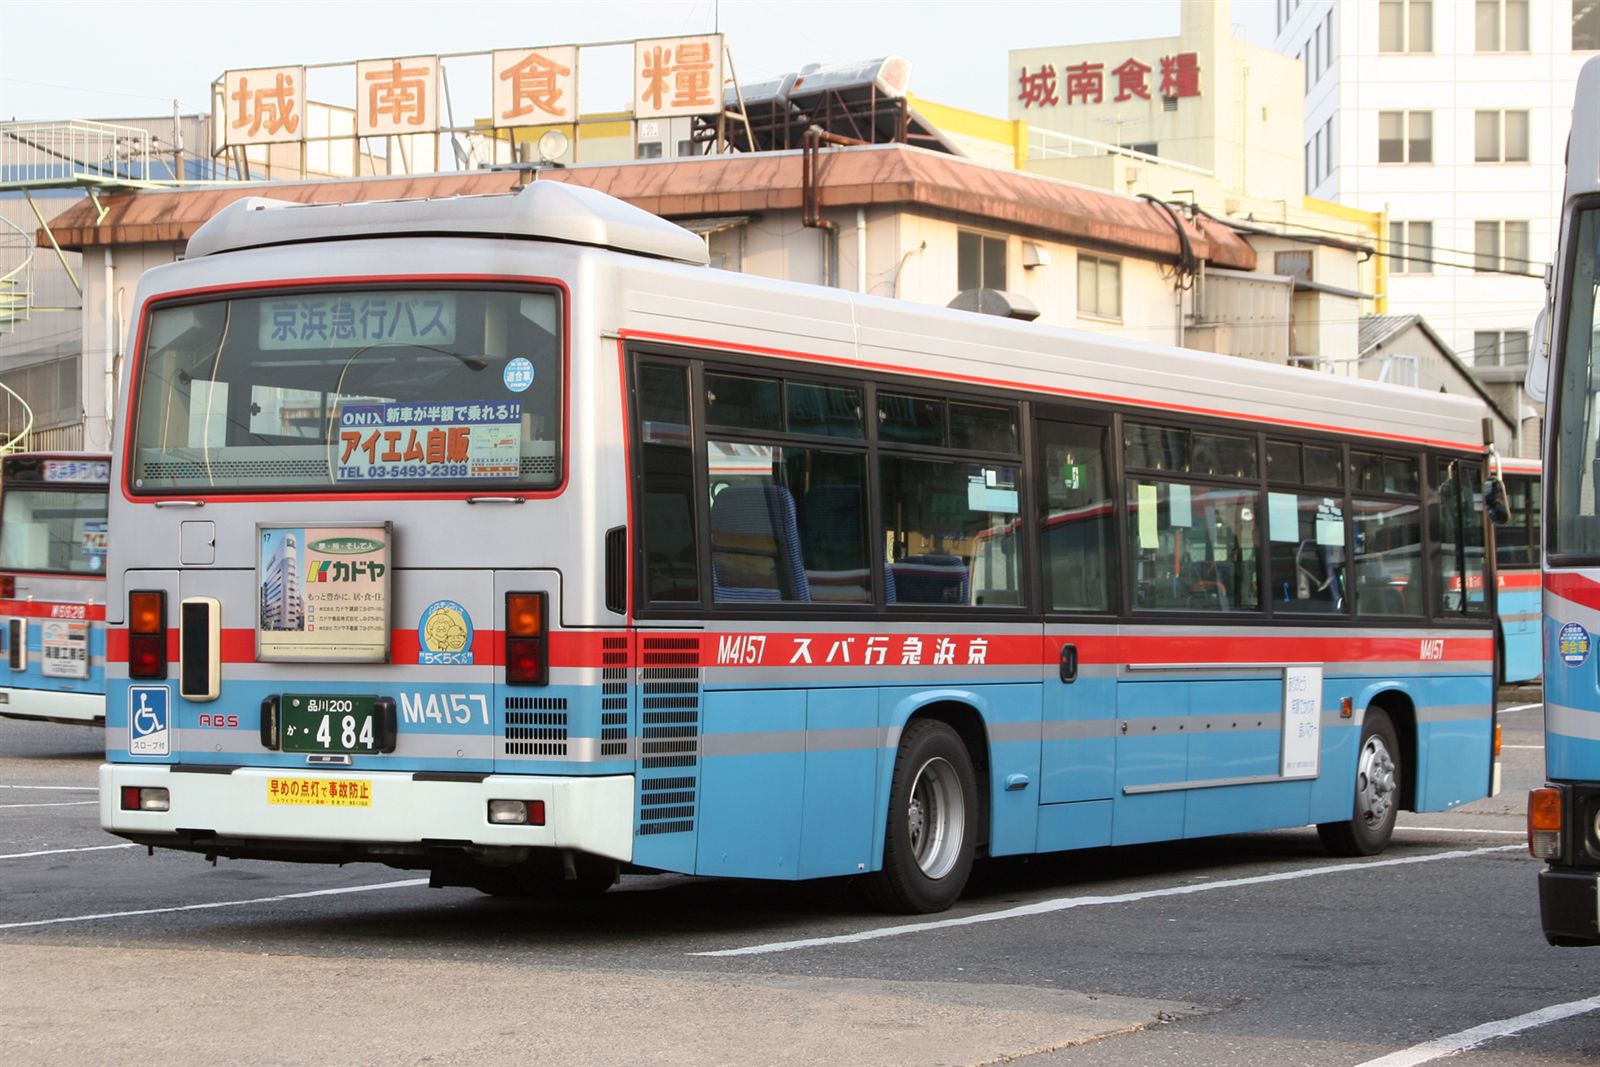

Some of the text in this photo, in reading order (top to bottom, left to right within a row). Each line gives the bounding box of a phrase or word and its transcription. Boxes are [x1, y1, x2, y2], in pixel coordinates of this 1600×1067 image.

[231, 42, 715, 137] 城南食糧
[1018, 52, 1201, 108] 城南食糧
[271, 299, 448, 342] 京浜急行バス
[386, 403, 521, 423] 新車が半額で乗れる!!
[340, 427, 471, 465] アイエム自販
[339, 466, 364, 478] TEL
[368, 464, 468, 478] 03-5493-2388
[263, 533, 271, 542] 17
[332, 560, 385, 582] カドヤ
[717, 635, 767, 665] M4157
[1420, 639, 1444, 660] M4157
[399, 692, 490, 725] M4157
[199, 714, 238, 728] ABS
[270, 779, 369, 799] 早めの点灯で事故防止
